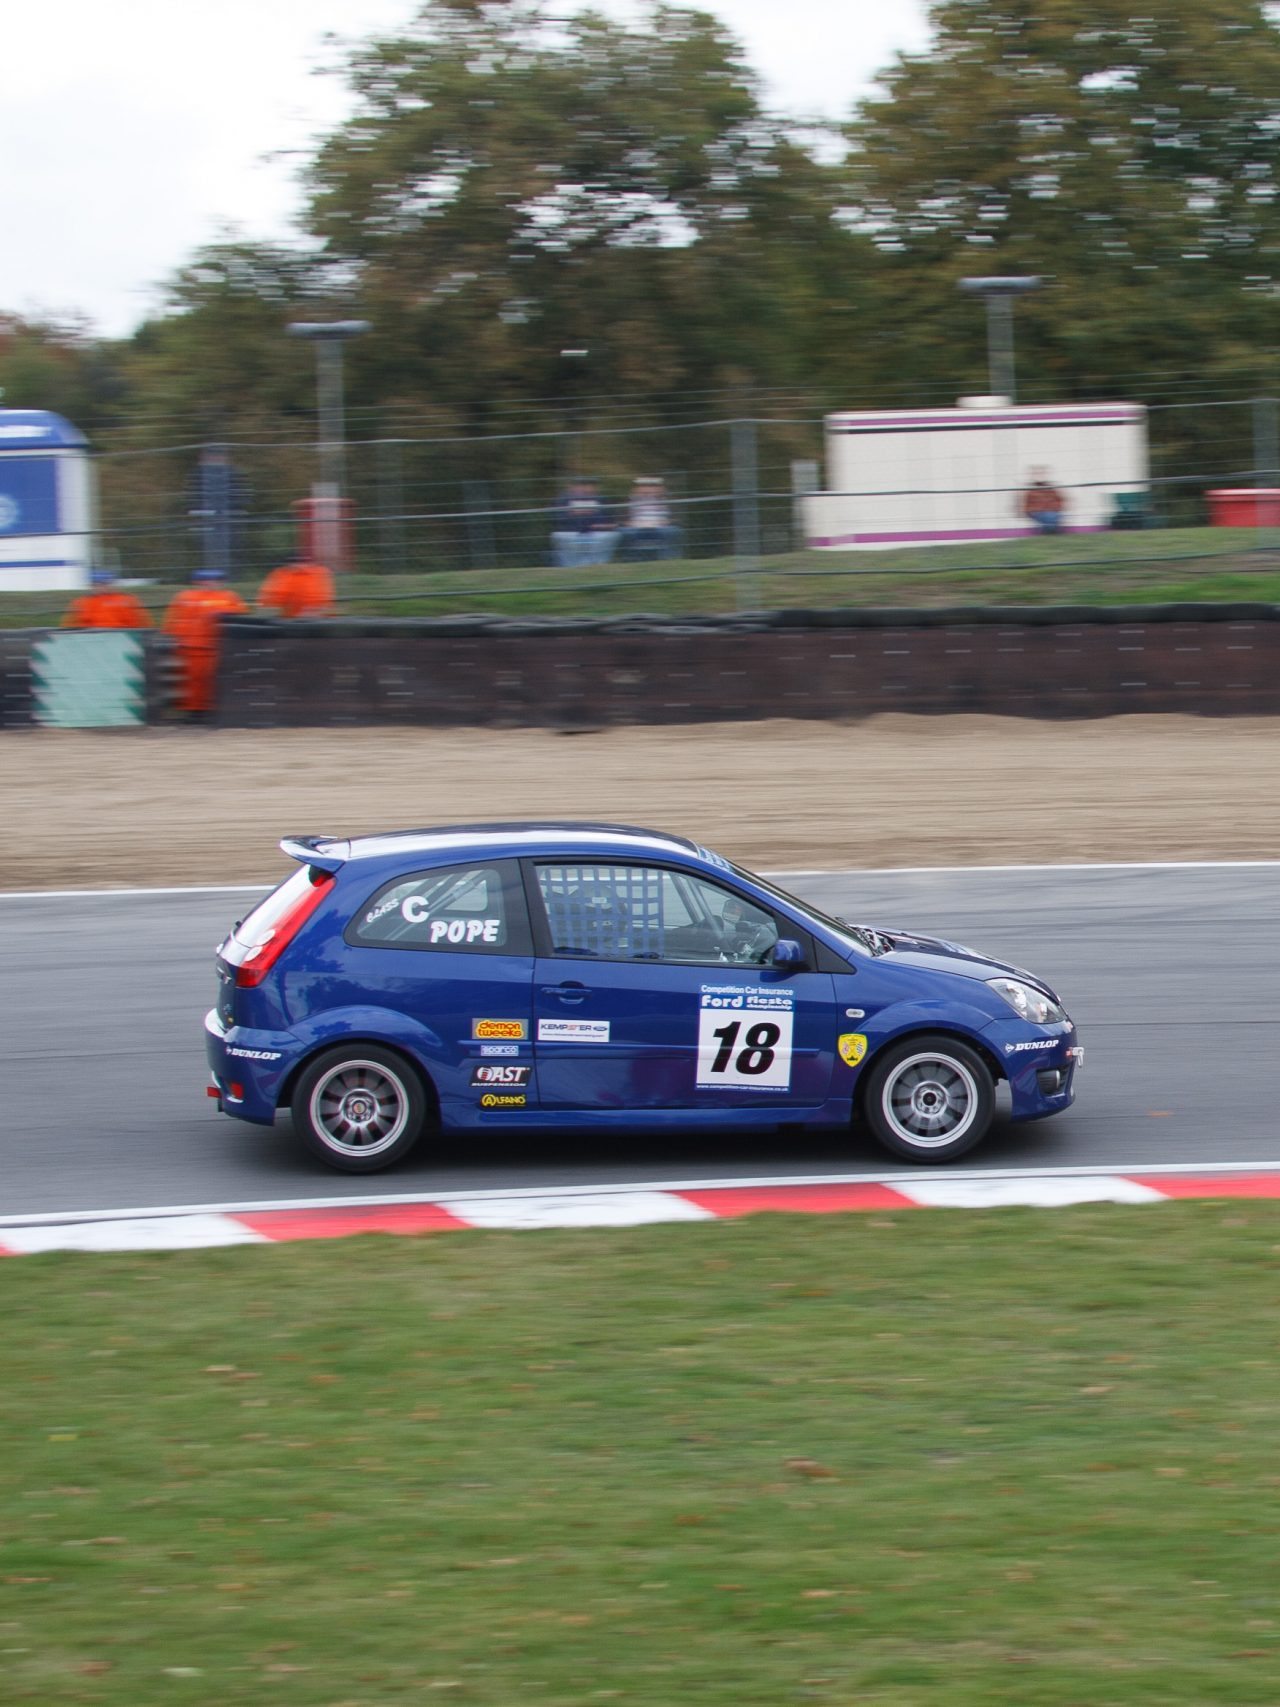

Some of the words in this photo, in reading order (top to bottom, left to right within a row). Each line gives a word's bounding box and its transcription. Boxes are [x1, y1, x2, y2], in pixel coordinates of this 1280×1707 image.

[401, 895, 430, 923] C
[430, 919, 500, 943] POPE
[701, 984, 745, 994] Competition
[745, 986, 758, 995] Car
[758, 986, 794, 996] Insurance
[701, 995, 743, 1008] Ford
[479, 1020, 520, 1030] demon
[477, 1028, 522, 1037] tweeks
[711, 1021, 781, 1075] 18
[1015, 1039, 1059, 1051] DUNLOP
[231, 1049, 281, 1060] DUNLOP
[482, 1093, 526, 1107] ALFANO
